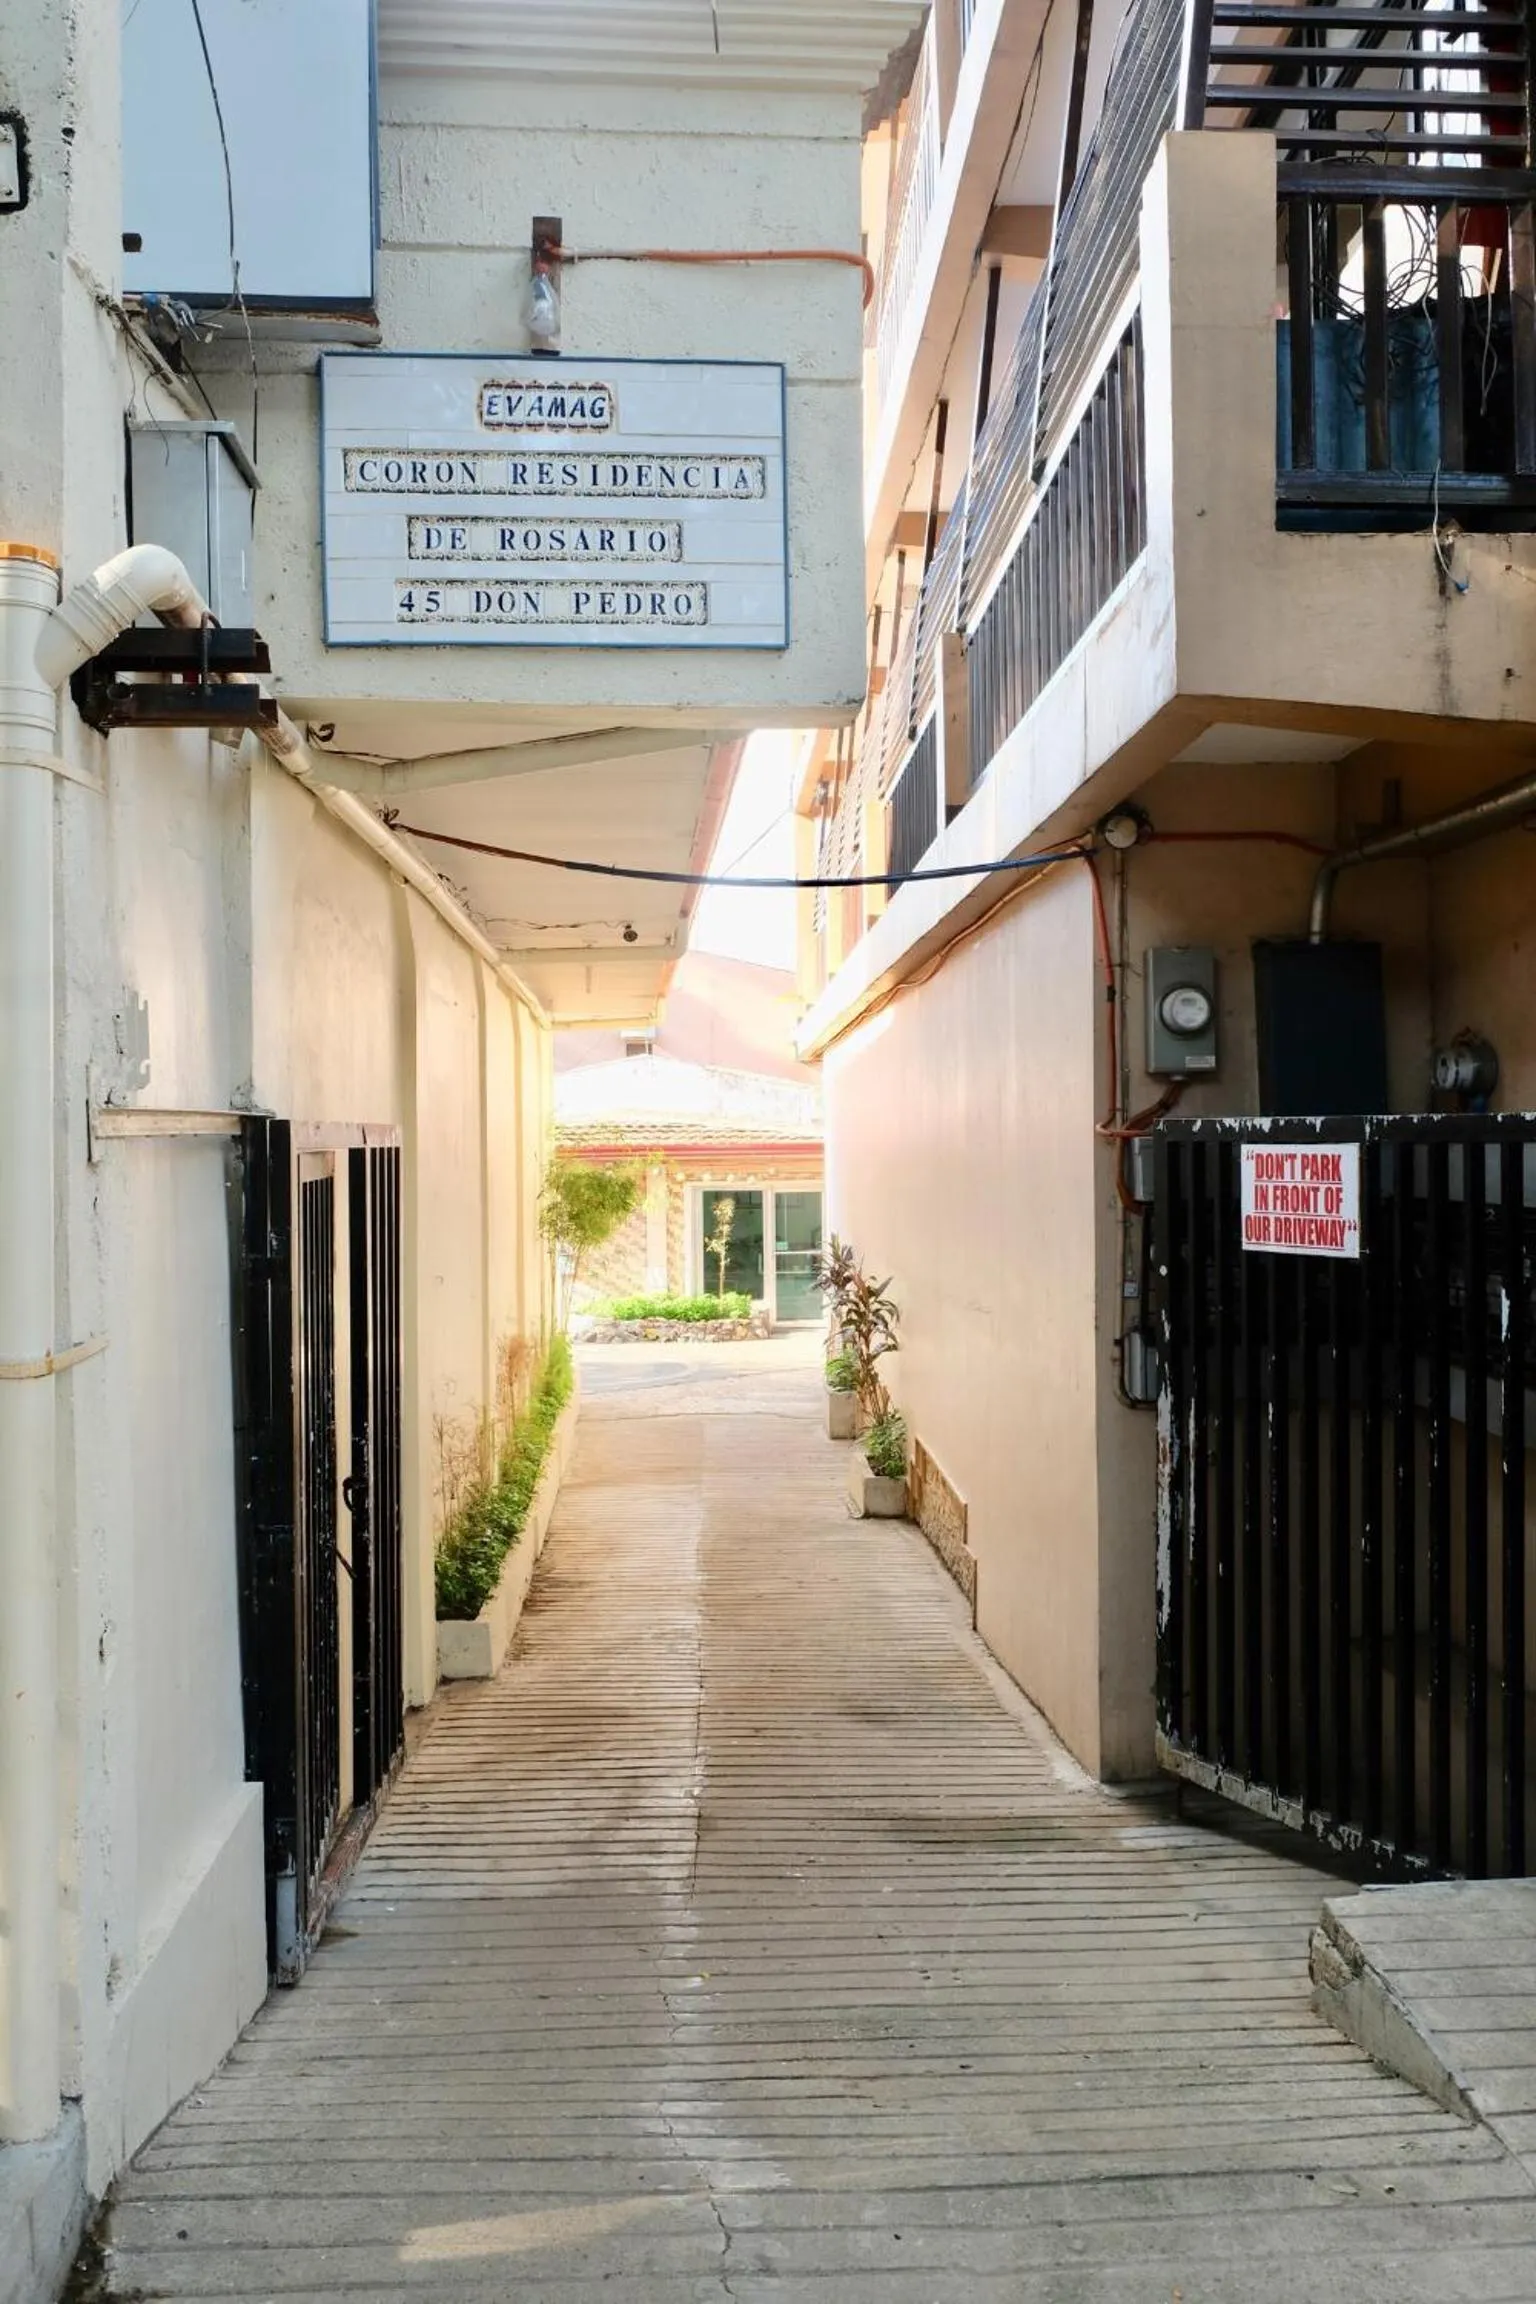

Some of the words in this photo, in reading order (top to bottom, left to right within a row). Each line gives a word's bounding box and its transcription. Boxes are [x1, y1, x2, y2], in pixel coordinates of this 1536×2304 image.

[486, 394, 606, 420] EVAMAG
[359, 459, 479, 484] CORON
[512, 462, 751, 488] RESIDENCIA
[425, 527, 467, 550] DE
[500, 528, 667, 553] ROSARIO
[399, 590, 441, 613] 45
[475, 590, 541, 614] DON
[574, 593, 692, 617] PEDRO
[1301, 1153, 1342, 1181] PARK
[1254, 1184, 1268, 1210] IN
[1273, 1185, 1319, 1213] FRONT
[1324, 1187, 1343, 1214] OF
[1245, 1214, 1270, 1241] OUR
